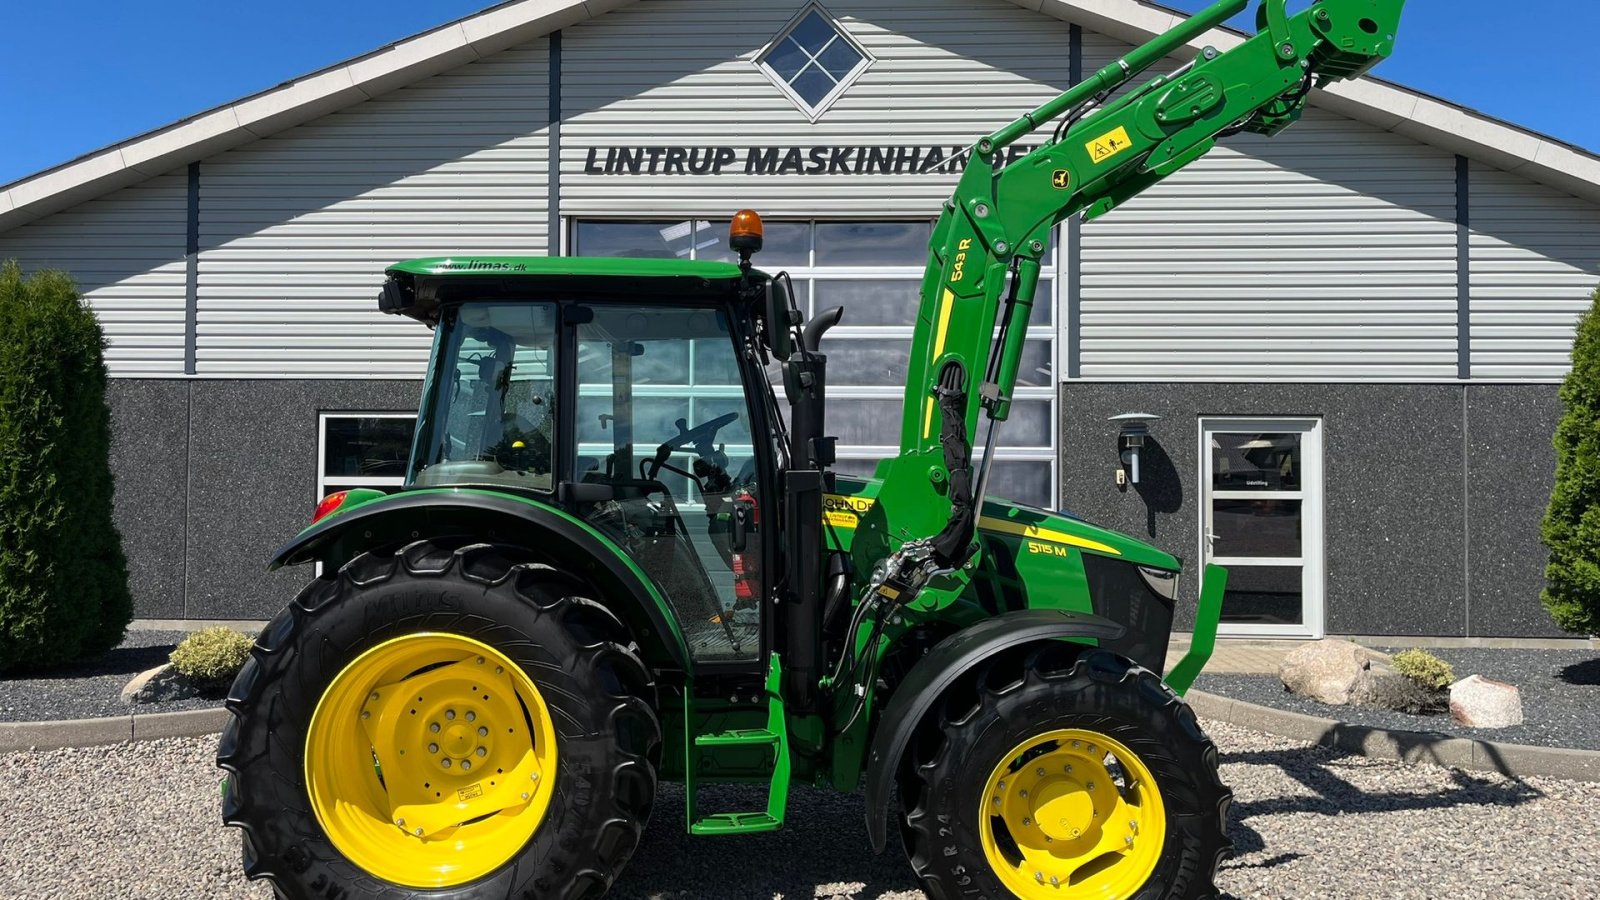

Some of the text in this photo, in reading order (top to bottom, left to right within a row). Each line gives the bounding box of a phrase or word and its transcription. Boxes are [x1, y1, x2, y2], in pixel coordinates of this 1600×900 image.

[584, 146, 736, 175] LINTRUP
[950, 237, 972, 282] 543 R
[1028, 541, 1067, 557] 5115 M
[937, 814, 953, 837] 24
